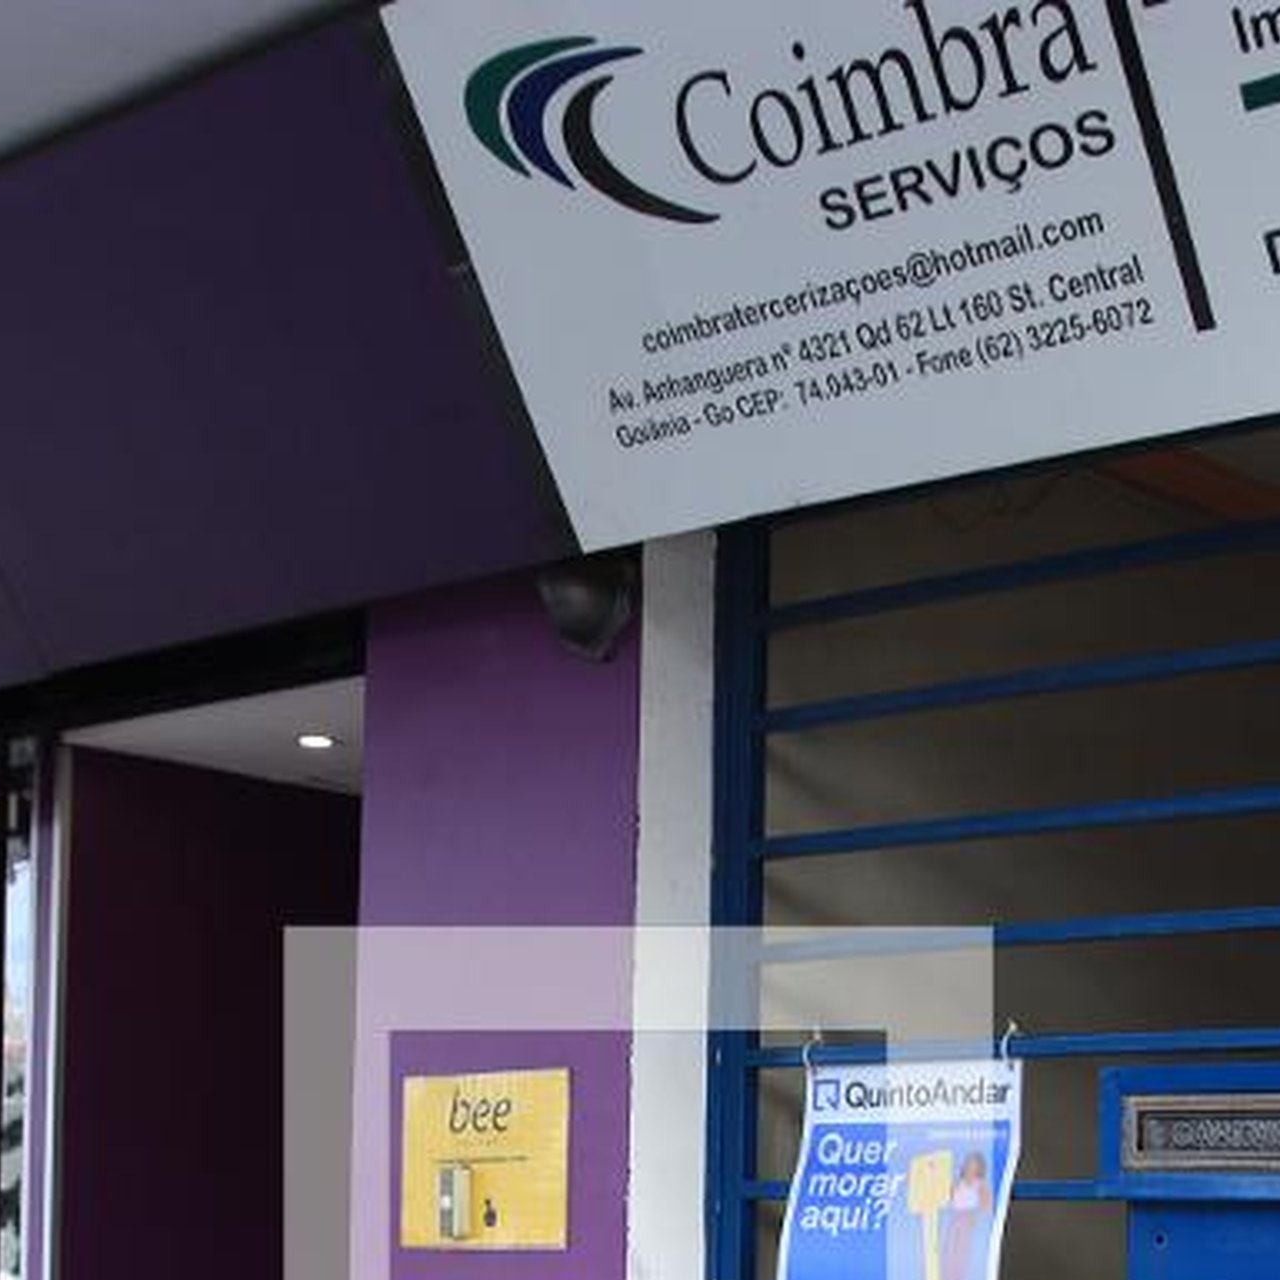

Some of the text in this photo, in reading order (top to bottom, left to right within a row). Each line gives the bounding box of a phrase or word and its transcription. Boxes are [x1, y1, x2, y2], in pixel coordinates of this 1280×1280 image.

[675, 0, 1098, 185] Coimbra
[821, 109, 1116, 231] SERVIÇOS
[608, 386, 641, 414] Av.
[642, 355, 769, 403] Anhanguera
[798, 329, 852, 363] 4321
[855, 318, 892, 351] Qd
[895, 309, 926, 342] 62
[928, 303, 957, 333] Lt
[959, 289, 1005, 326] 160
[1006, 281, 1045, 314] St.
[1047, 253, 1145, 302] Central
[702, 401, 735, 428] Go
[793, 361, 899, 407] 74.043-01
[915, 346, 971, 379] Fone
[974, 326, 1024, 367] (62)
[448, 1082, 513, 1135] bee
[845, 1077, 1011, 1110] QuintoAndar
[817, 1131, 899, 1166] Quer
[807, 1170, 908, 1199] morar
[799, 1198, 892, 1238] aqui?
